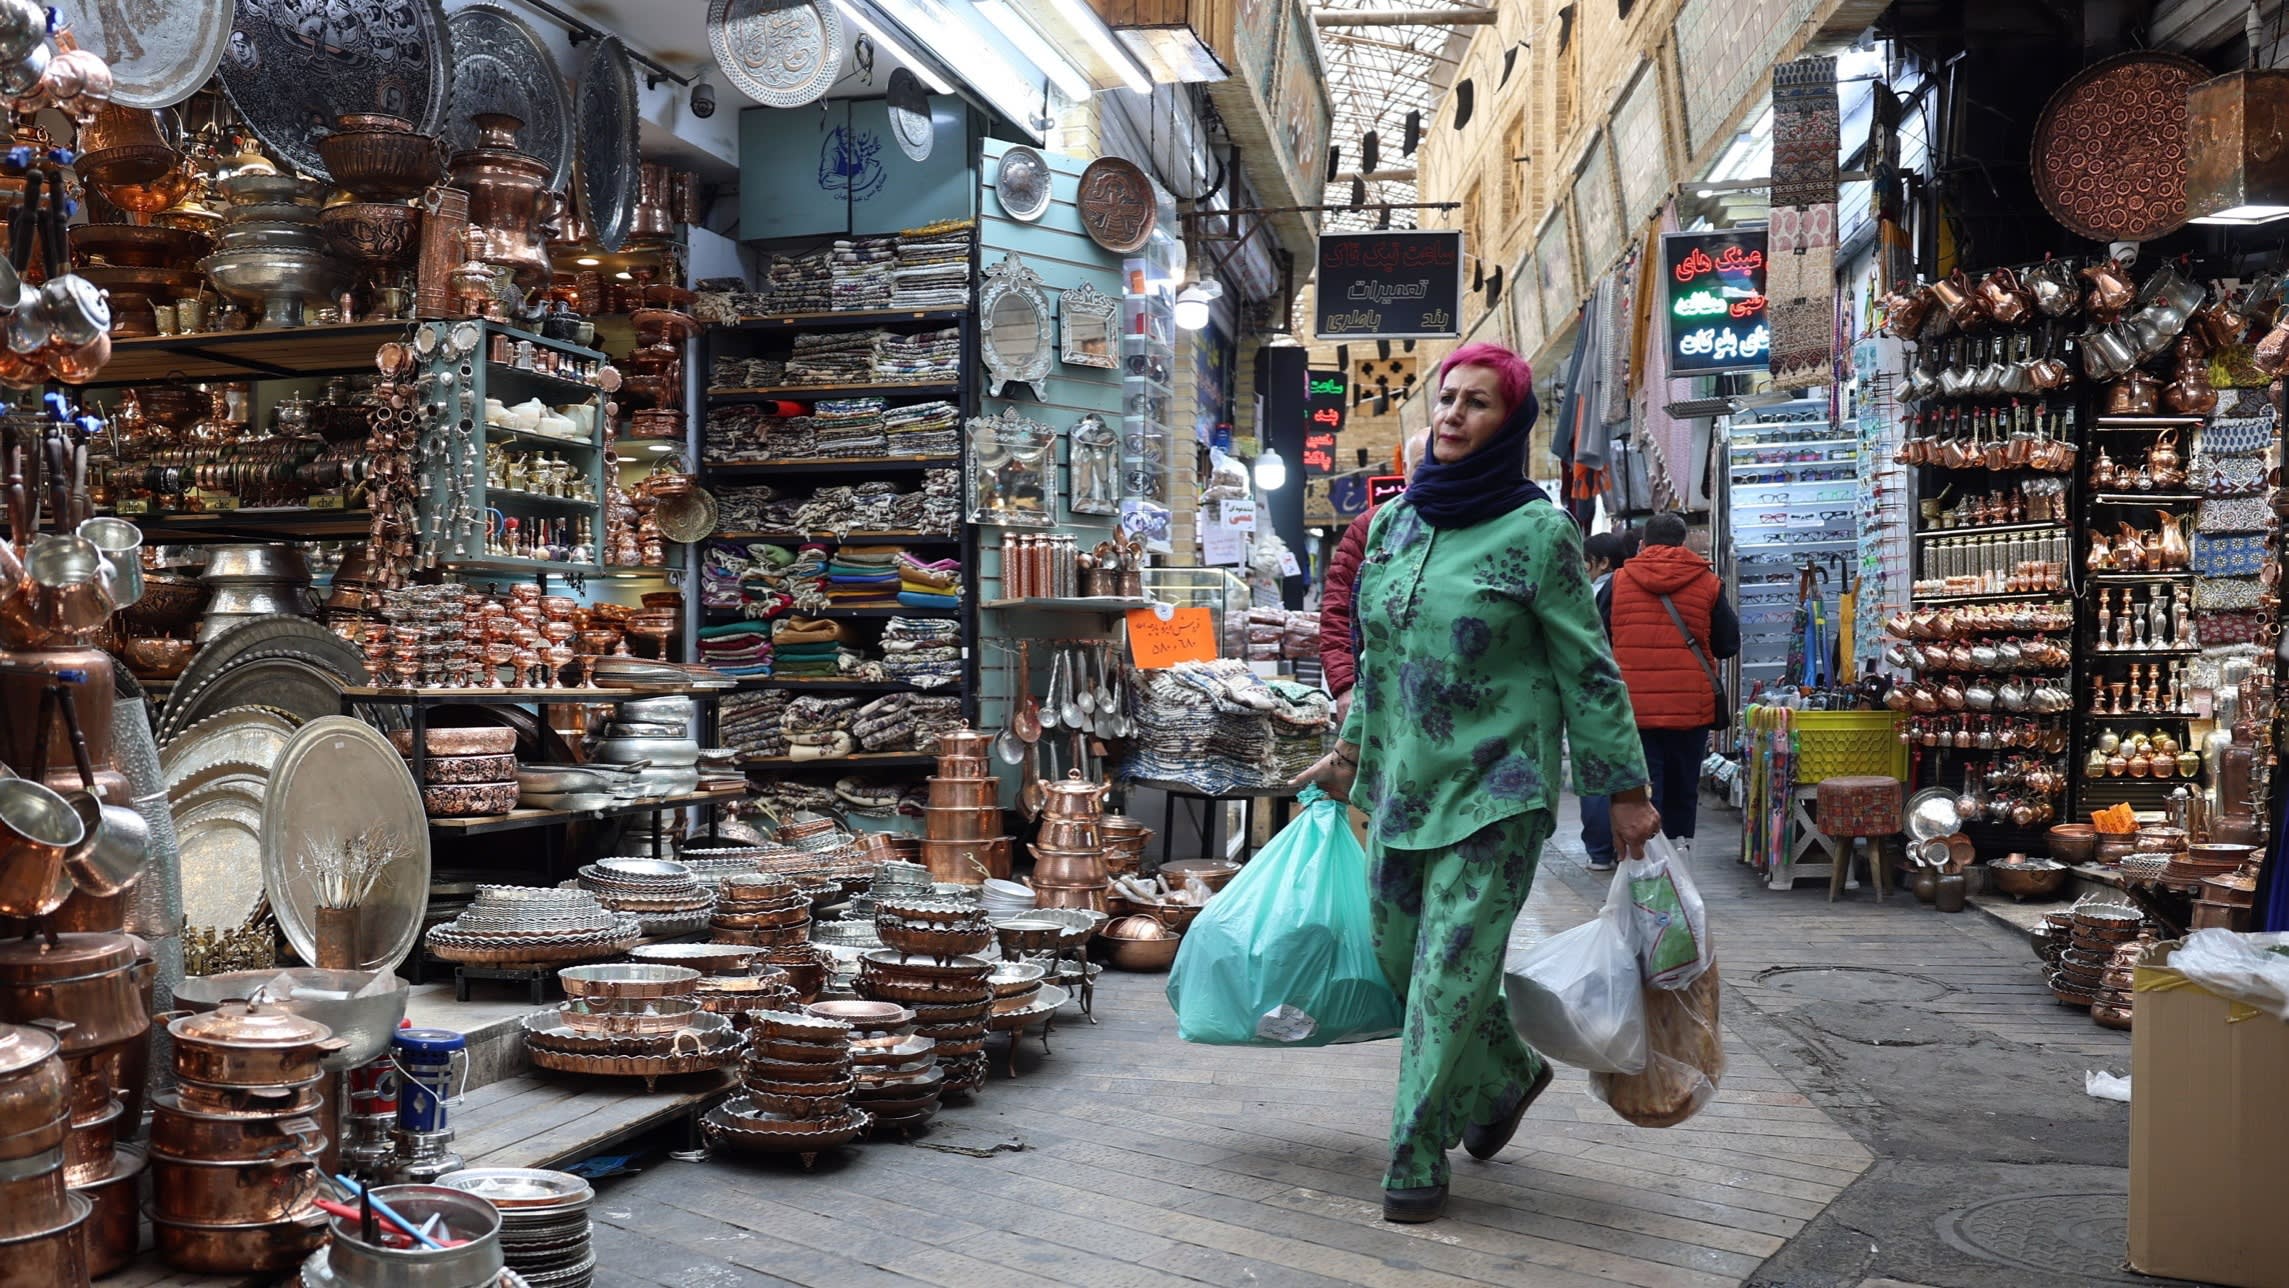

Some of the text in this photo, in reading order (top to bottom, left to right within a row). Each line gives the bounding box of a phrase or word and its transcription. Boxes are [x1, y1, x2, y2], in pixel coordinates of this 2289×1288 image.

[1324, 240, 1456, 273] ساعت تیک تاک
[1675, 246, 1762, 282] عینک های
[1347, 279, 1429, 304] تعمیرات
[1326, 308, 1449, 332] بند باطری
[1309, 379, 1344, 394] ساعت
[1314, 408, 1340, 427] بند
